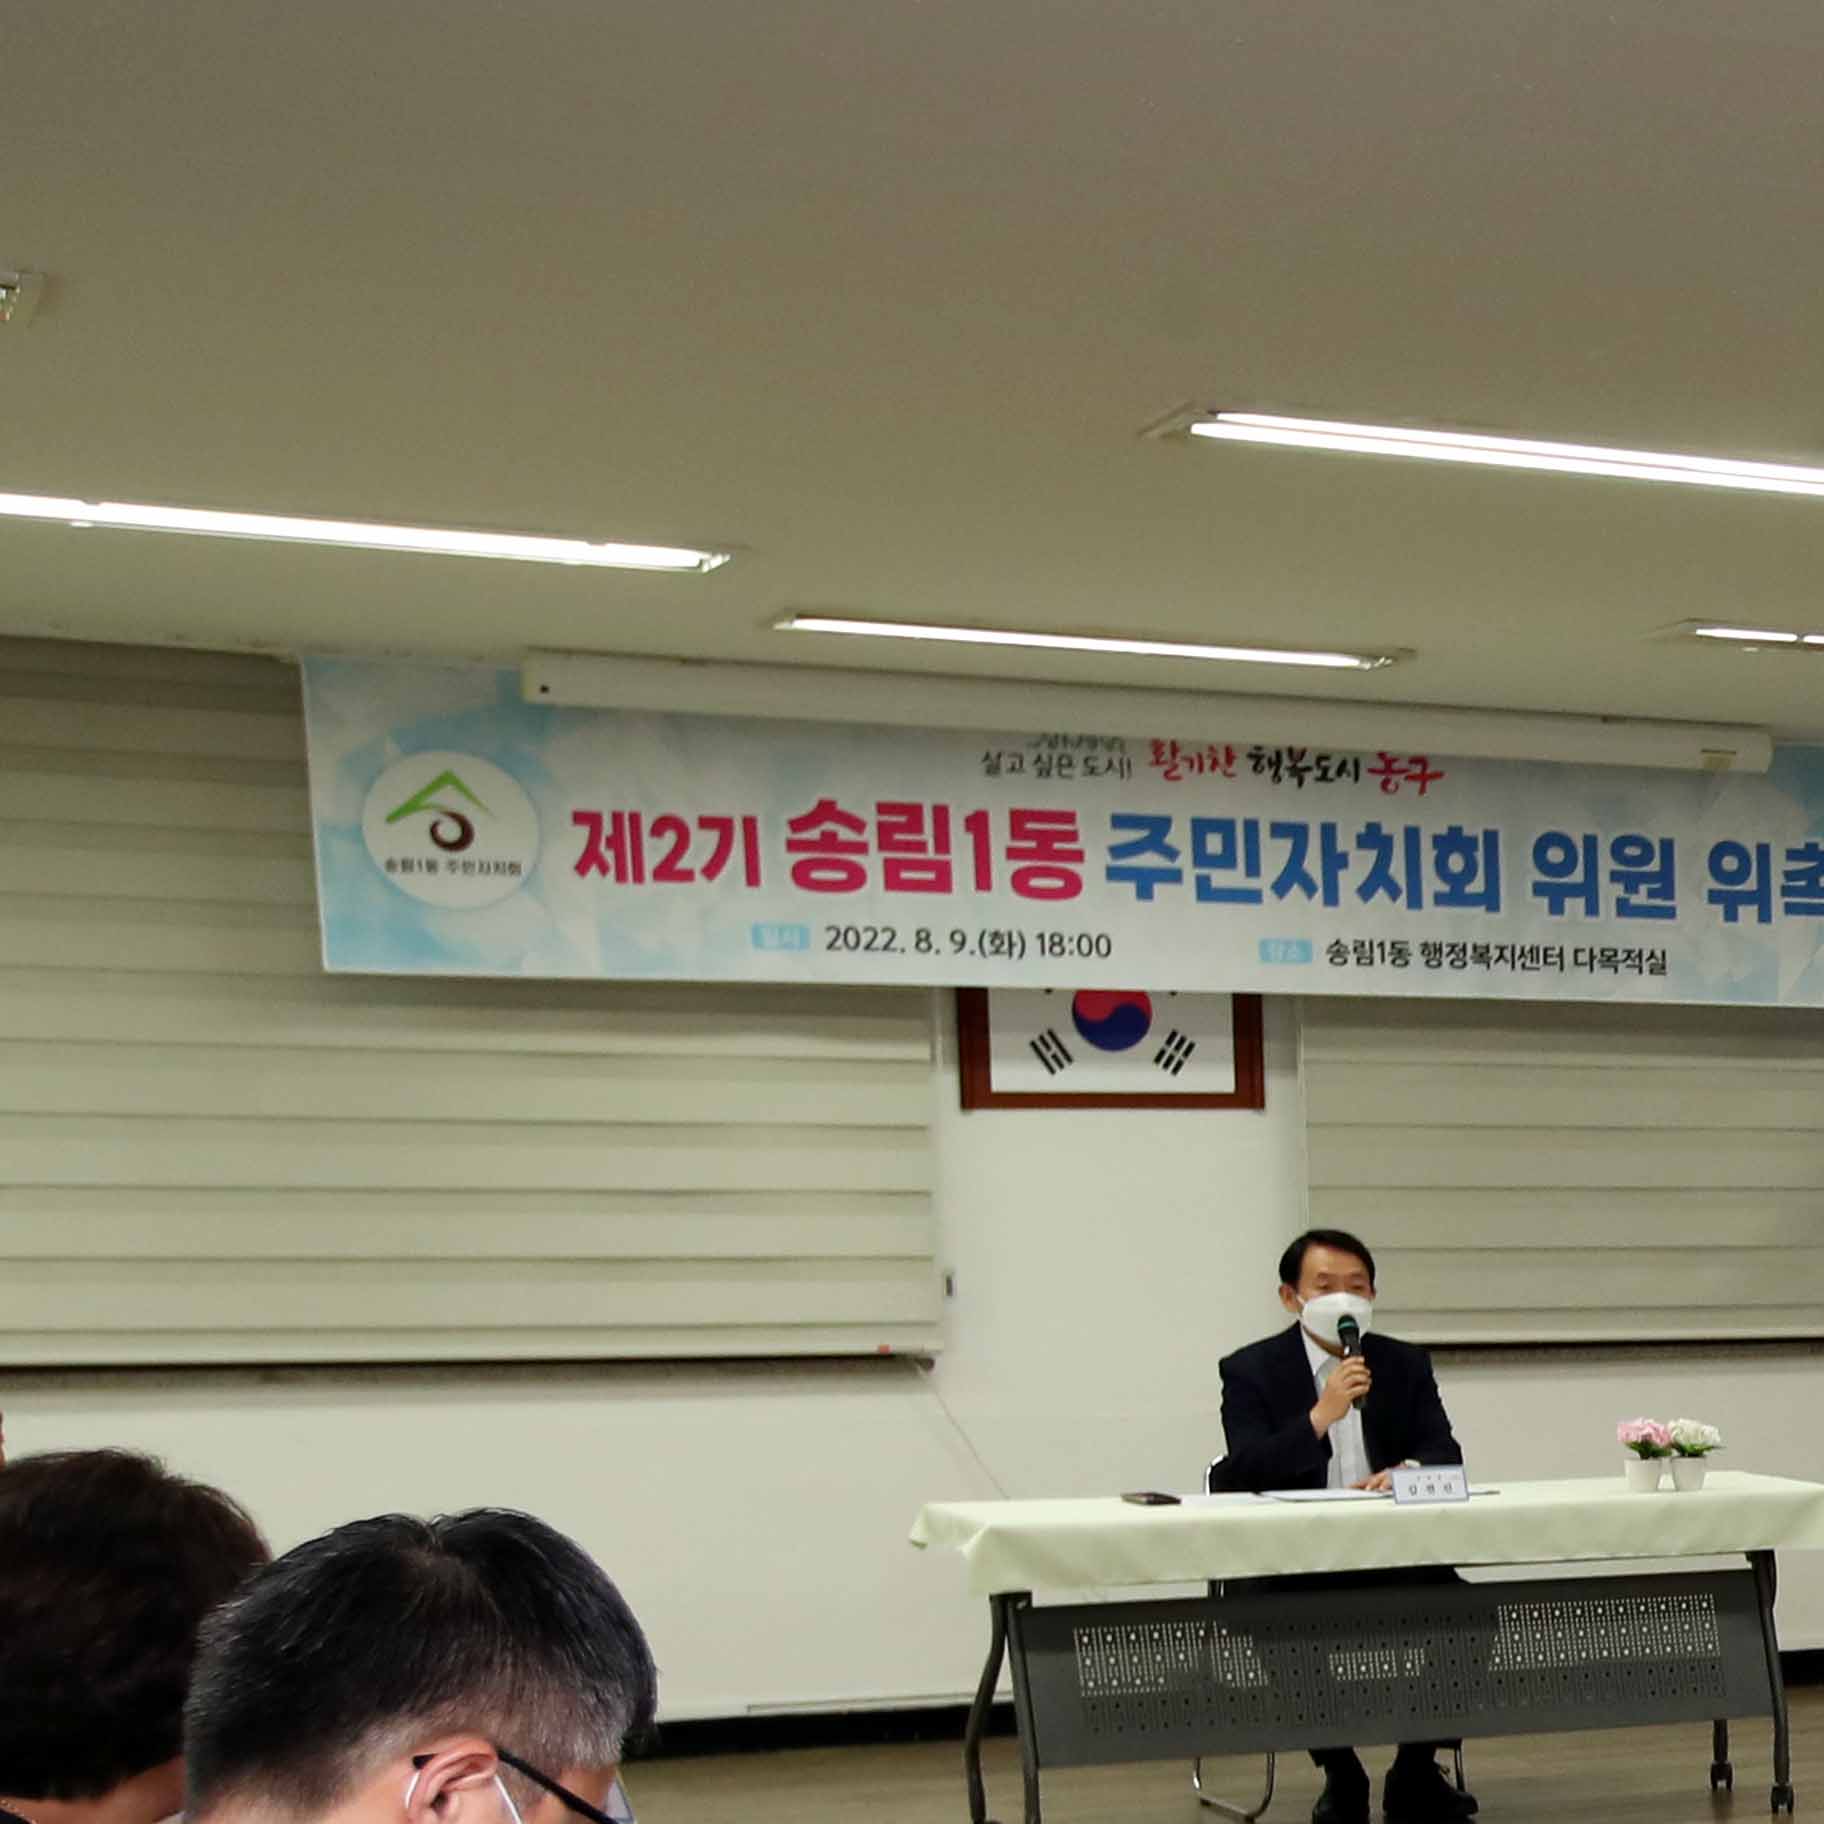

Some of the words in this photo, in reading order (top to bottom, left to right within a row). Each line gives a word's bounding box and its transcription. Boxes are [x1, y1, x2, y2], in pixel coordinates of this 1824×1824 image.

[1247, 746, 1360, 788] 행복도시
[572, 810, 762, 888] 제2기
[786, 799, 1085, 900] 송림1동
[1104, 811, 1501, 914] 주민자치회
[1531, 829, 1677, 920] 위원
[825, 925, 906, 953] 2022.
[914, 927, 940, 954] 8.
[1036, 932, 1113, 958] 18:00
[1326, 938, 1412, 969] 송림1동
[1420, 941, 1565, 973] 행정복지센터
[1573, 946, 1668, 976] 다목적실
